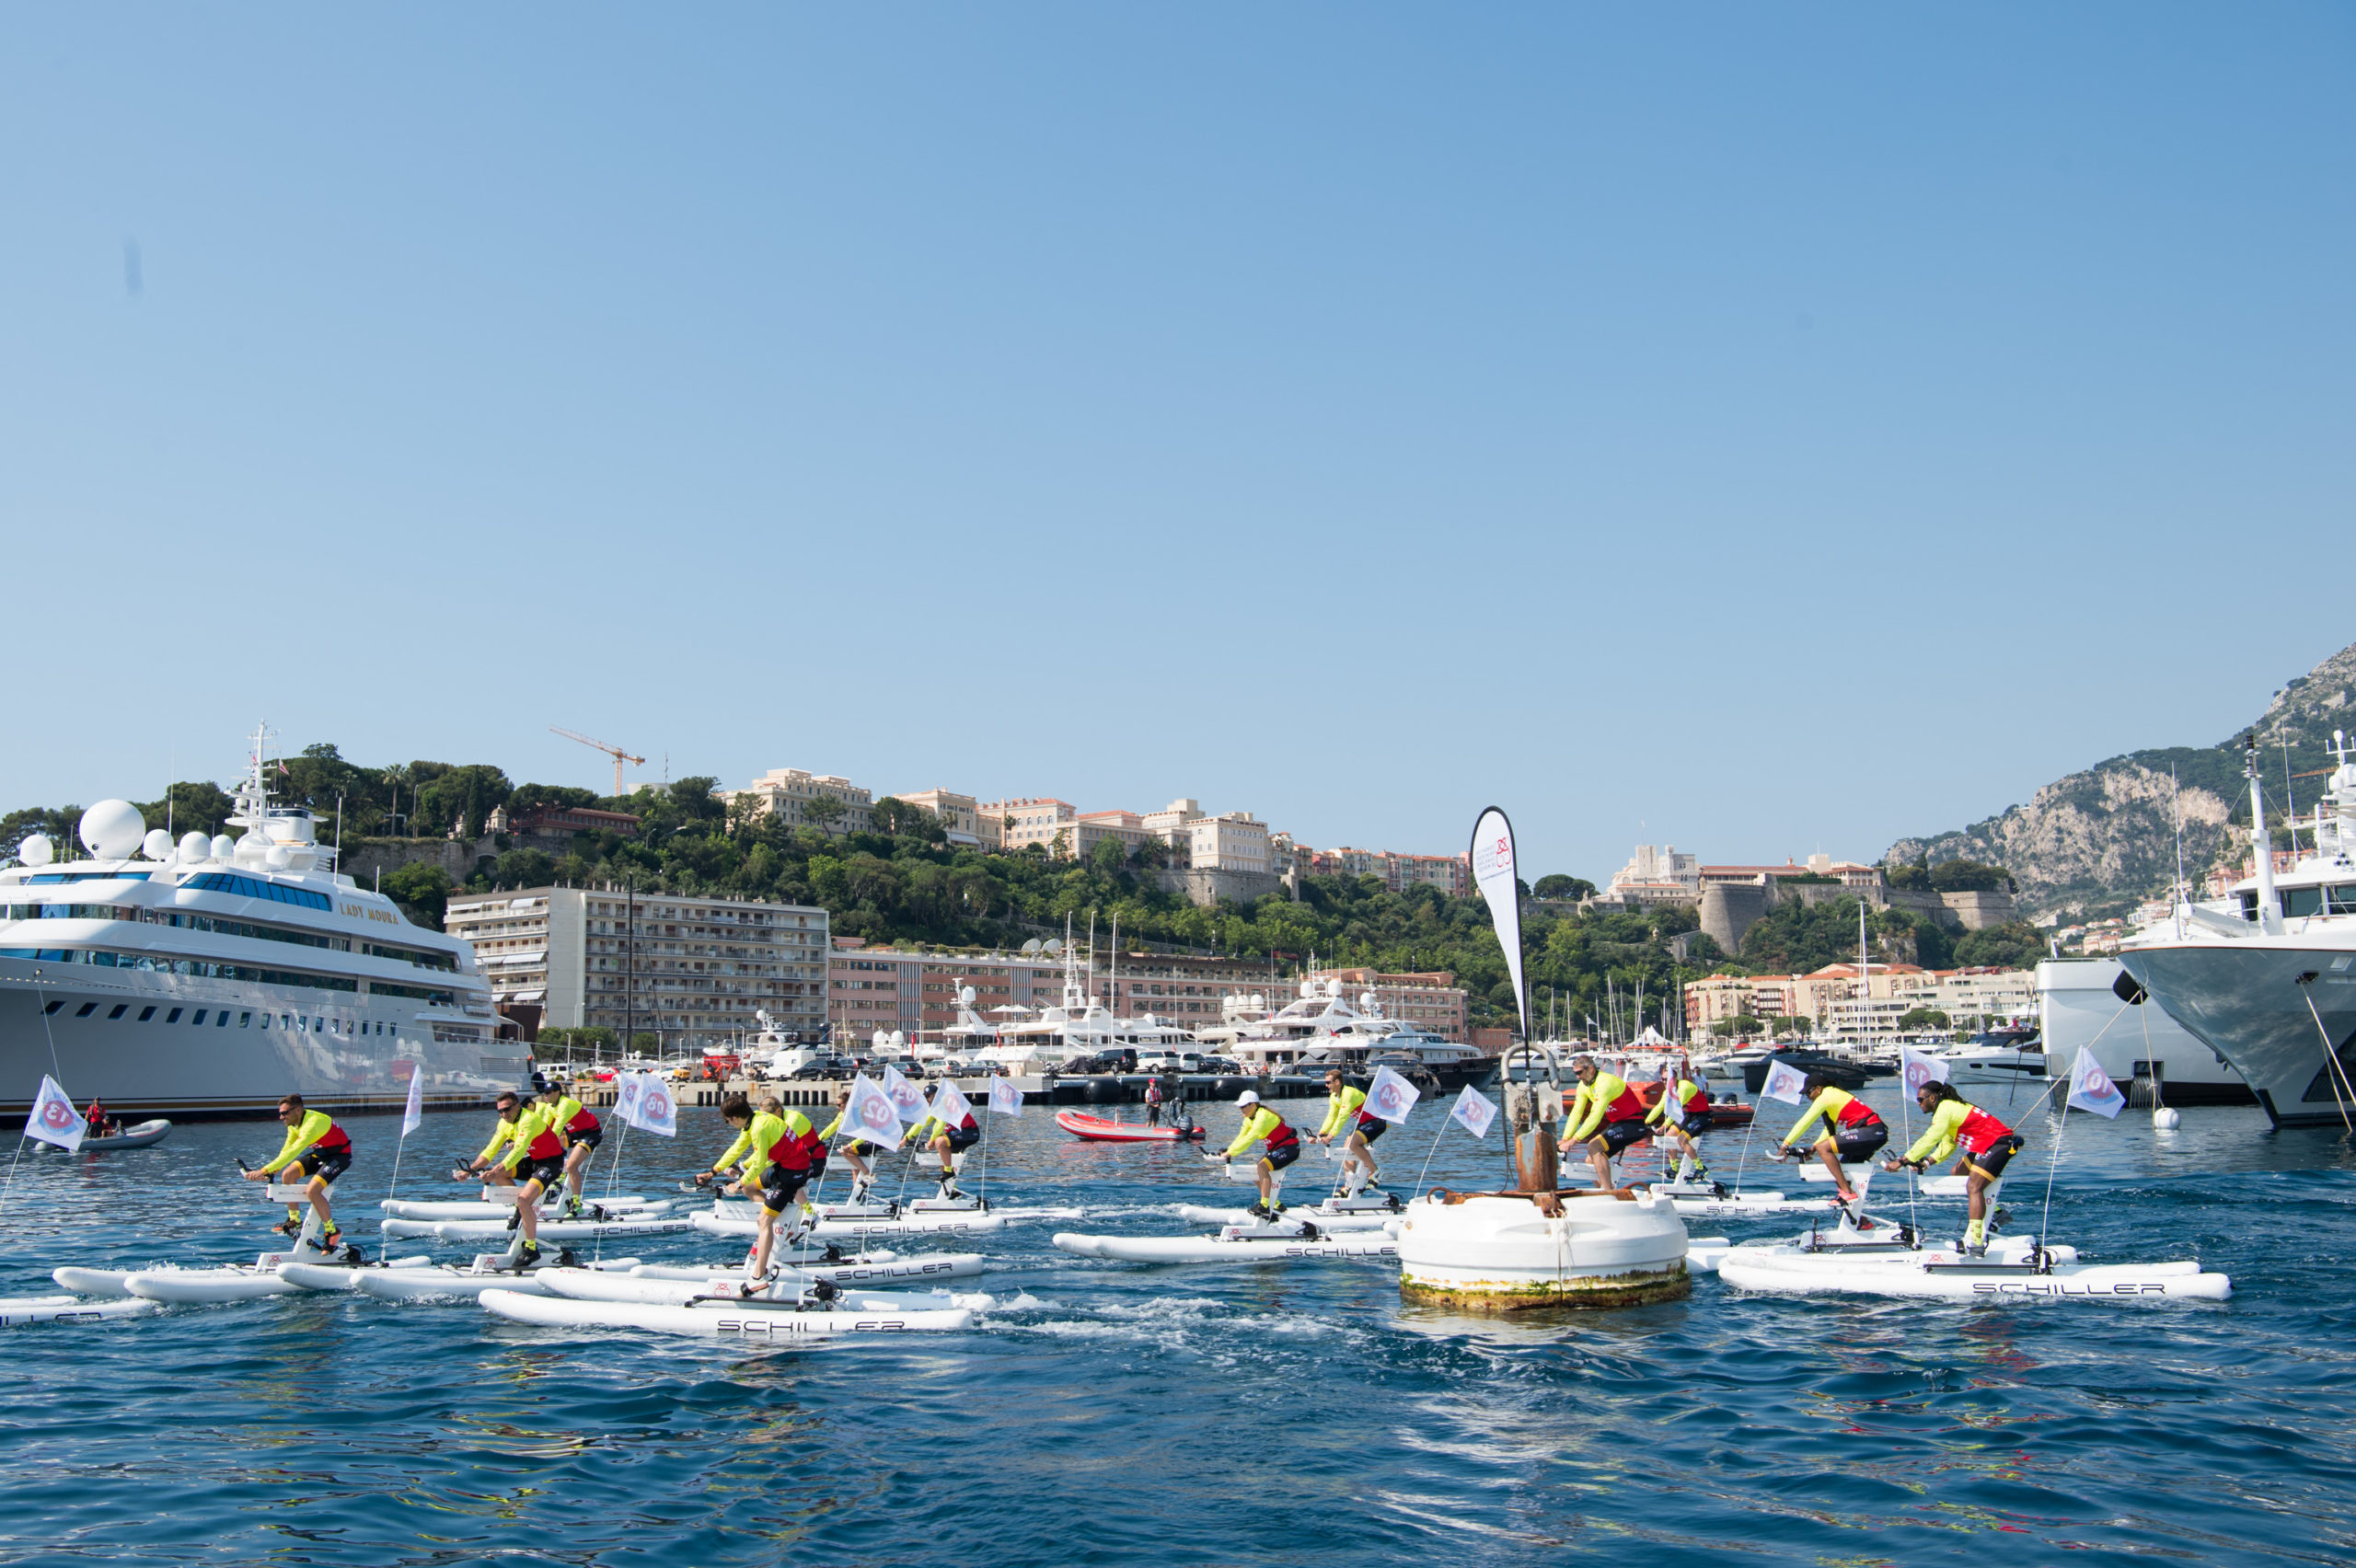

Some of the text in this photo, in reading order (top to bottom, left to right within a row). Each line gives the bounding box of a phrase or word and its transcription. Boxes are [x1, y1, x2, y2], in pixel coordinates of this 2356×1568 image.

[340, 902, 398, 925] LADY MOURA
[592, 1224, 688, 1236] SCHILLER
[853, 1223, 969, 1235] SCHILLER
[1286, 1247, 1396, 1257] SCHILLE
[835, 1262, 953, 1281] SCHILLER
[1973, 1283, 2166, 1295] SCHILLER
